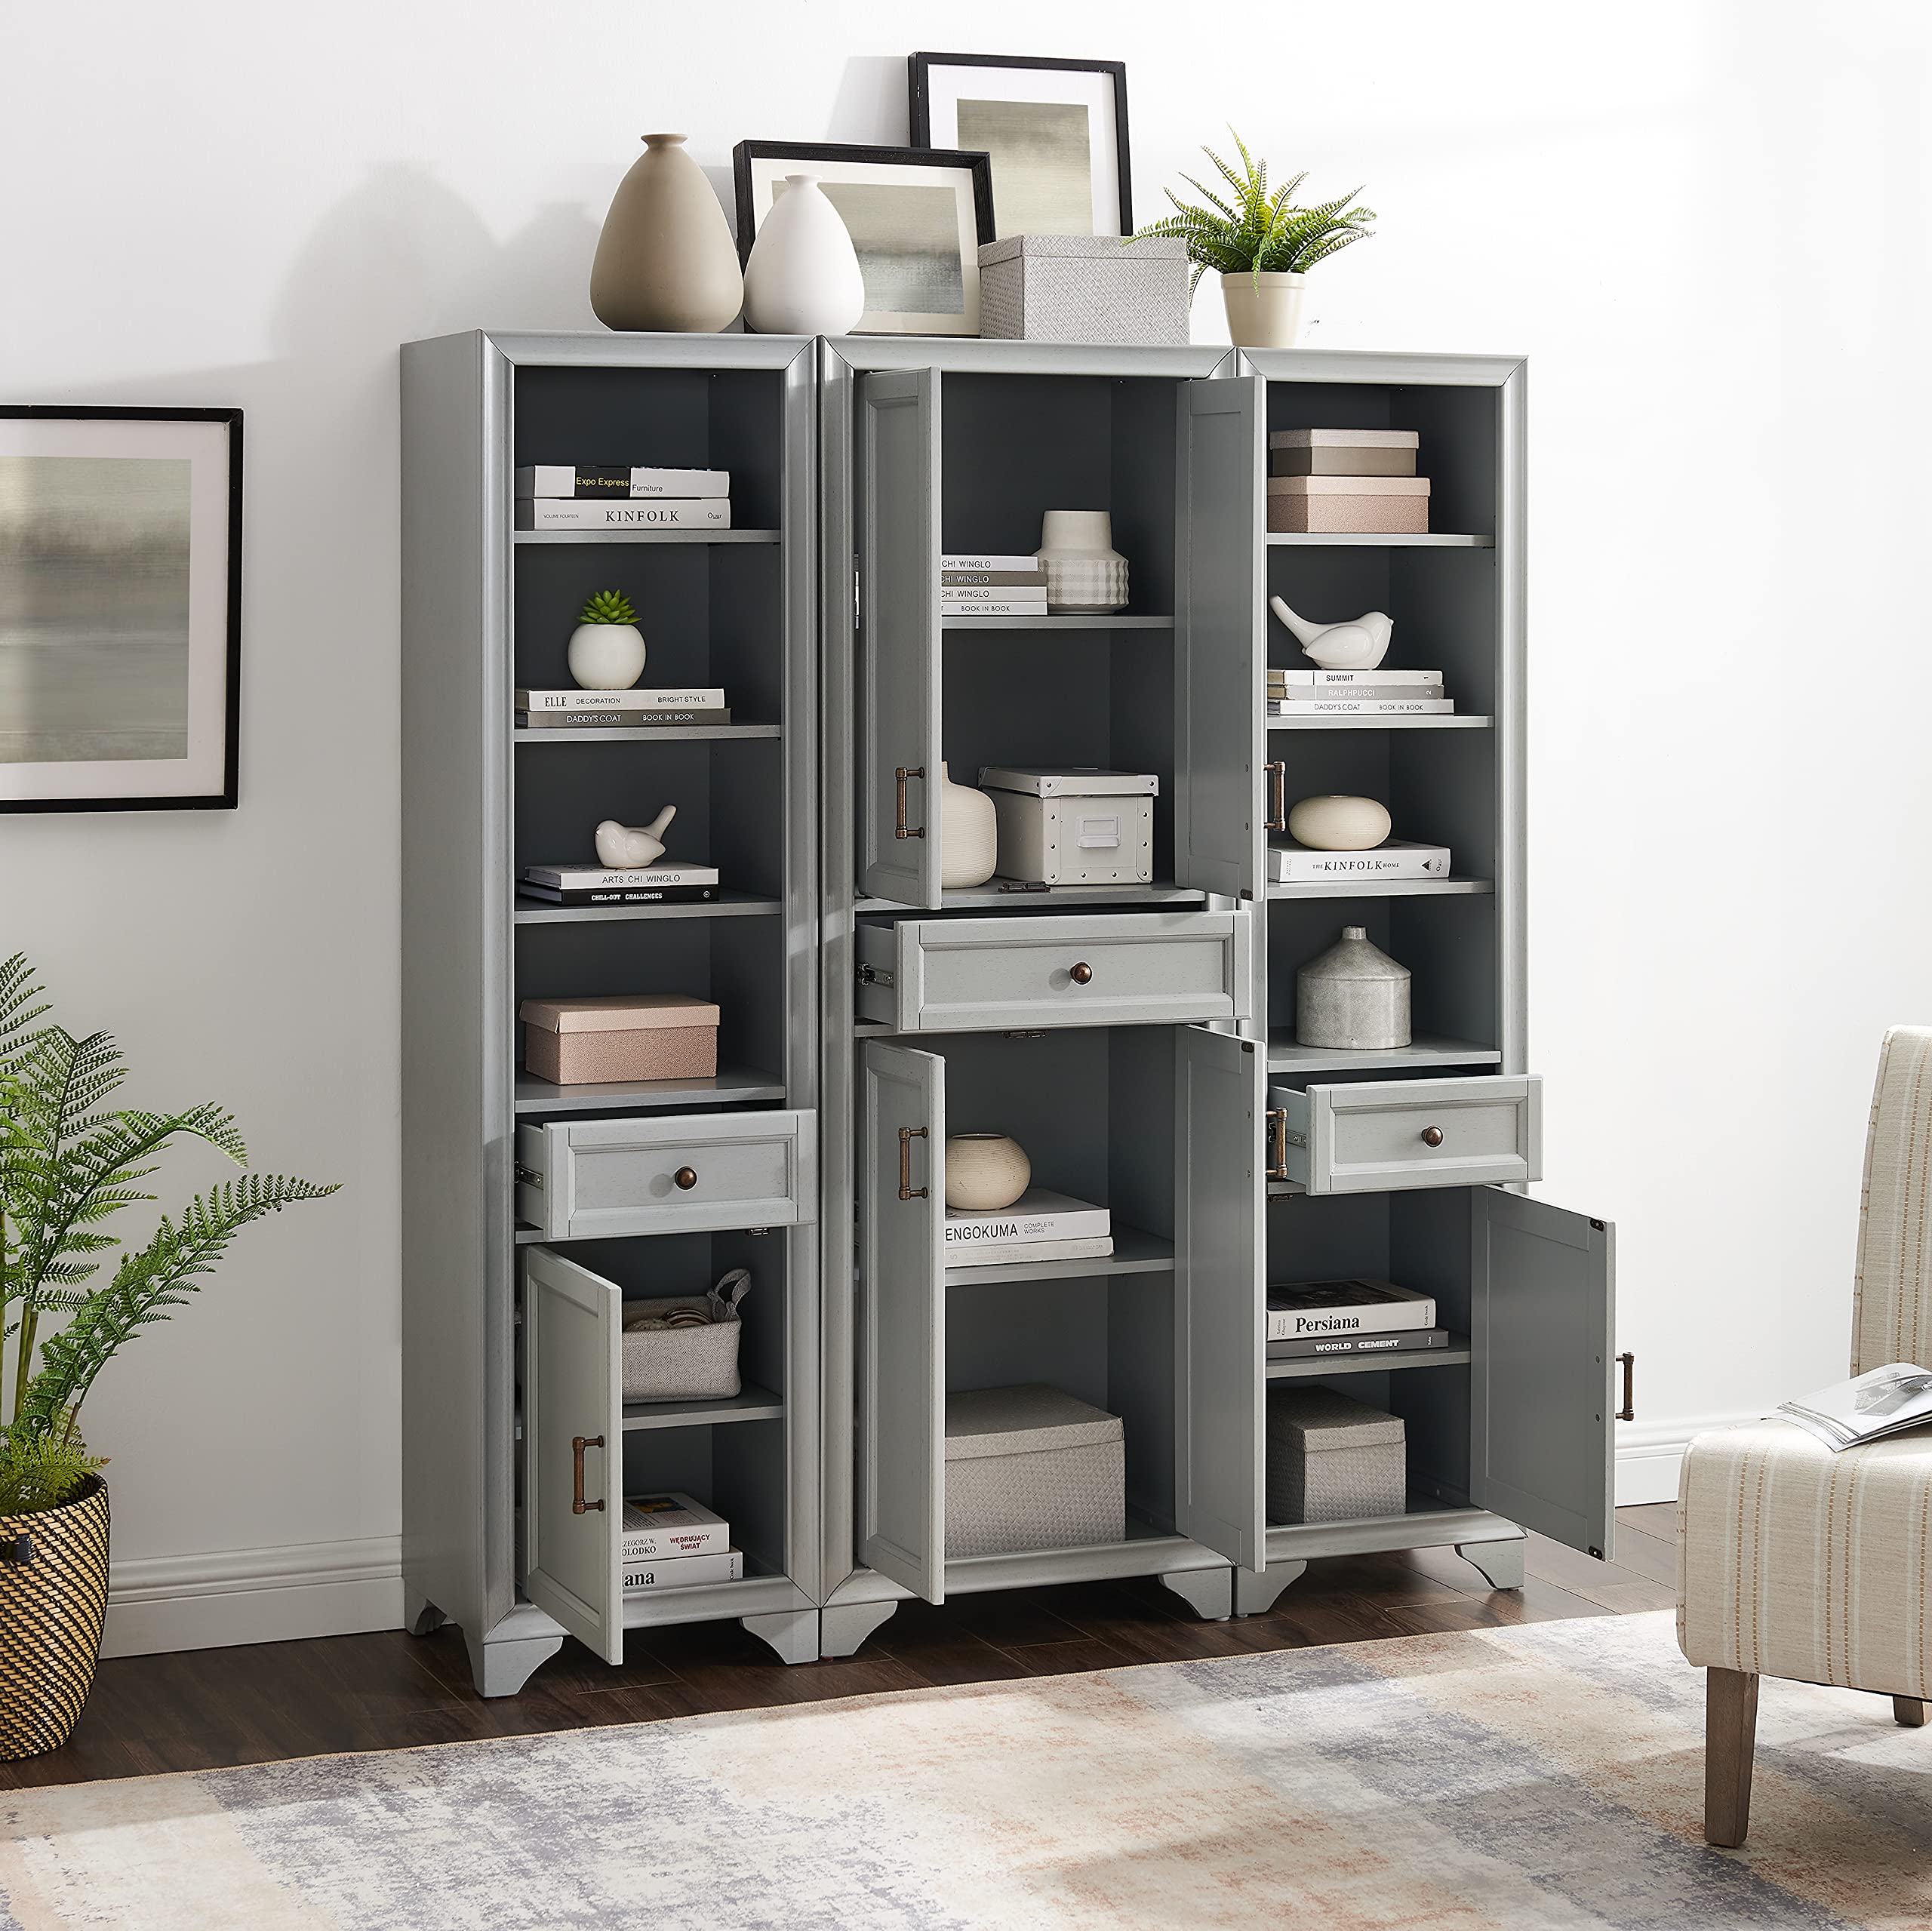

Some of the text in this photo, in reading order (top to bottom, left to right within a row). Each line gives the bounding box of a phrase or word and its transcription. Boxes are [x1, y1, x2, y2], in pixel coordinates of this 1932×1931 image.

[576, 477, 629, 487] Expo Express
[632, 484, 663, 493] Furniture
[605, 510, 680, 522] KINFOLK
[956, 575, 989, 583] WINGLO
[544, 696, 568, 707] ELLE
[599, 714, 621, 722] COAT
[1324, 860, 1383, 871] KINFOLK
[602, 874, 681, 884] ARTS CHI WINGLO
[946, 1222, 1019, 1241] ENGOKUMA
[1295, 1314, 1361, 1333] Persiana
[1315, 1339, 1399, 1352] WORLD CEMENT
[622, 1539, 648, 1547] ZEGORZ
